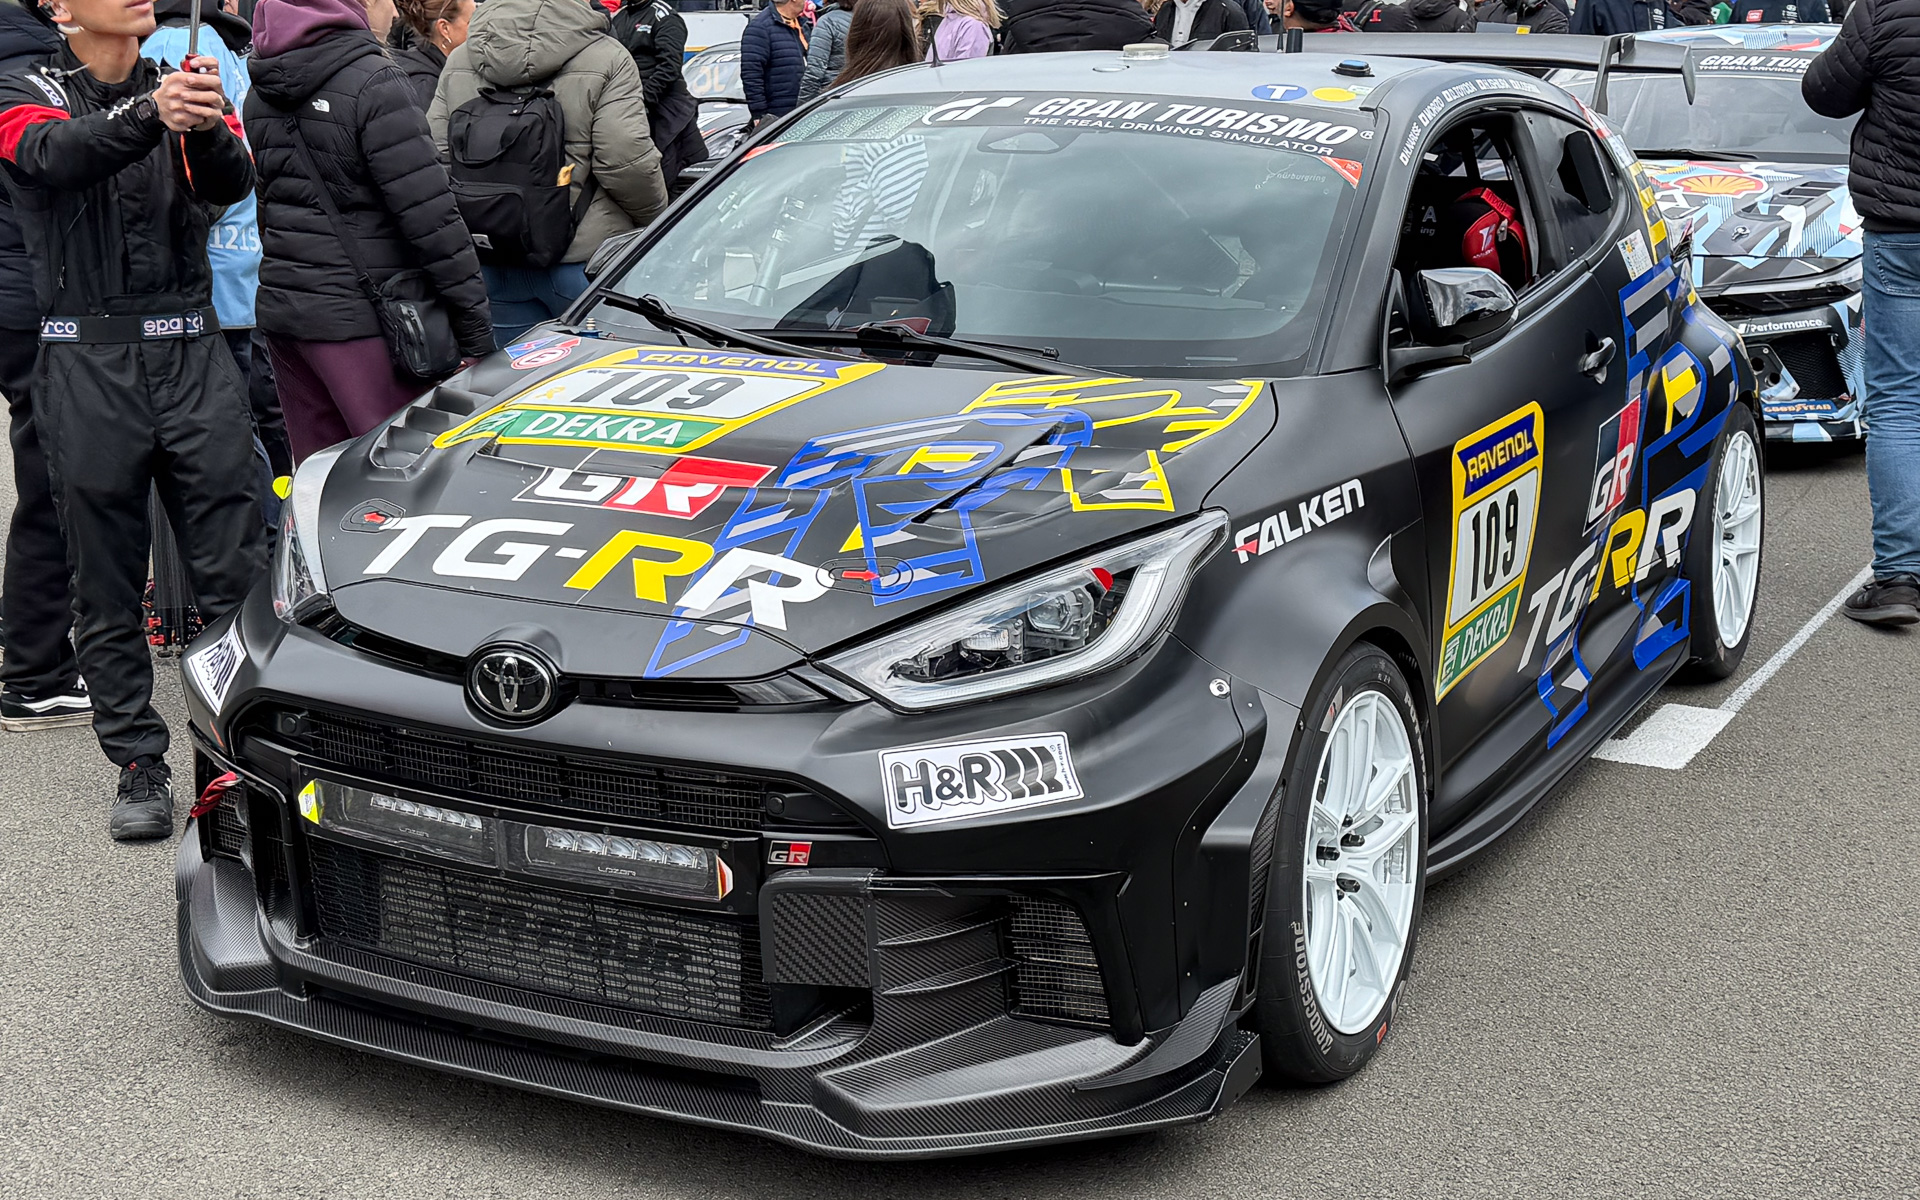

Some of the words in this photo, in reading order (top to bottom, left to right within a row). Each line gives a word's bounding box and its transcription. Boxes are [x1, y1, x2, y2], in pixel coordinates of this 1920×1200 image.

[1699, 55, 1767, 67] GRAN
[1028, 97, 1158, 119] GRAN
[1023, 116, 1061, 126] THE
[1063, 118, 1115, 129] REAL
[1119, 121, 1204, 137] DRIVING
[1208, 130, 1334, 156] SIMULATOR
[42, 320, 78, 334] rco
[1750, 319, 1822, 333] Performance
[640, 353, 826, 374] RAVENOL
[570, 371, 745, 410] 109
[1764, 403, 1832, 413] GOODYEAR
[520, 412, 684, 446] DEKRA
[1467, 429, 1533, 482] RAVENOL
[533, 468, 718, 514] GR
[1588, 442, 1635, 524] GR
[1232, 478, 1365, 565] FALKEN
[1470, 488, 1519, 603] 109
[362, 513, 835, 631] TG-RR
[1460, 596, 1510, 670] DEKRA
[893, 754, 998, 808] H&R
[769, 850, 808, 864] GR
[1290, 921, 1334, 1056] BRIDGESTONE
